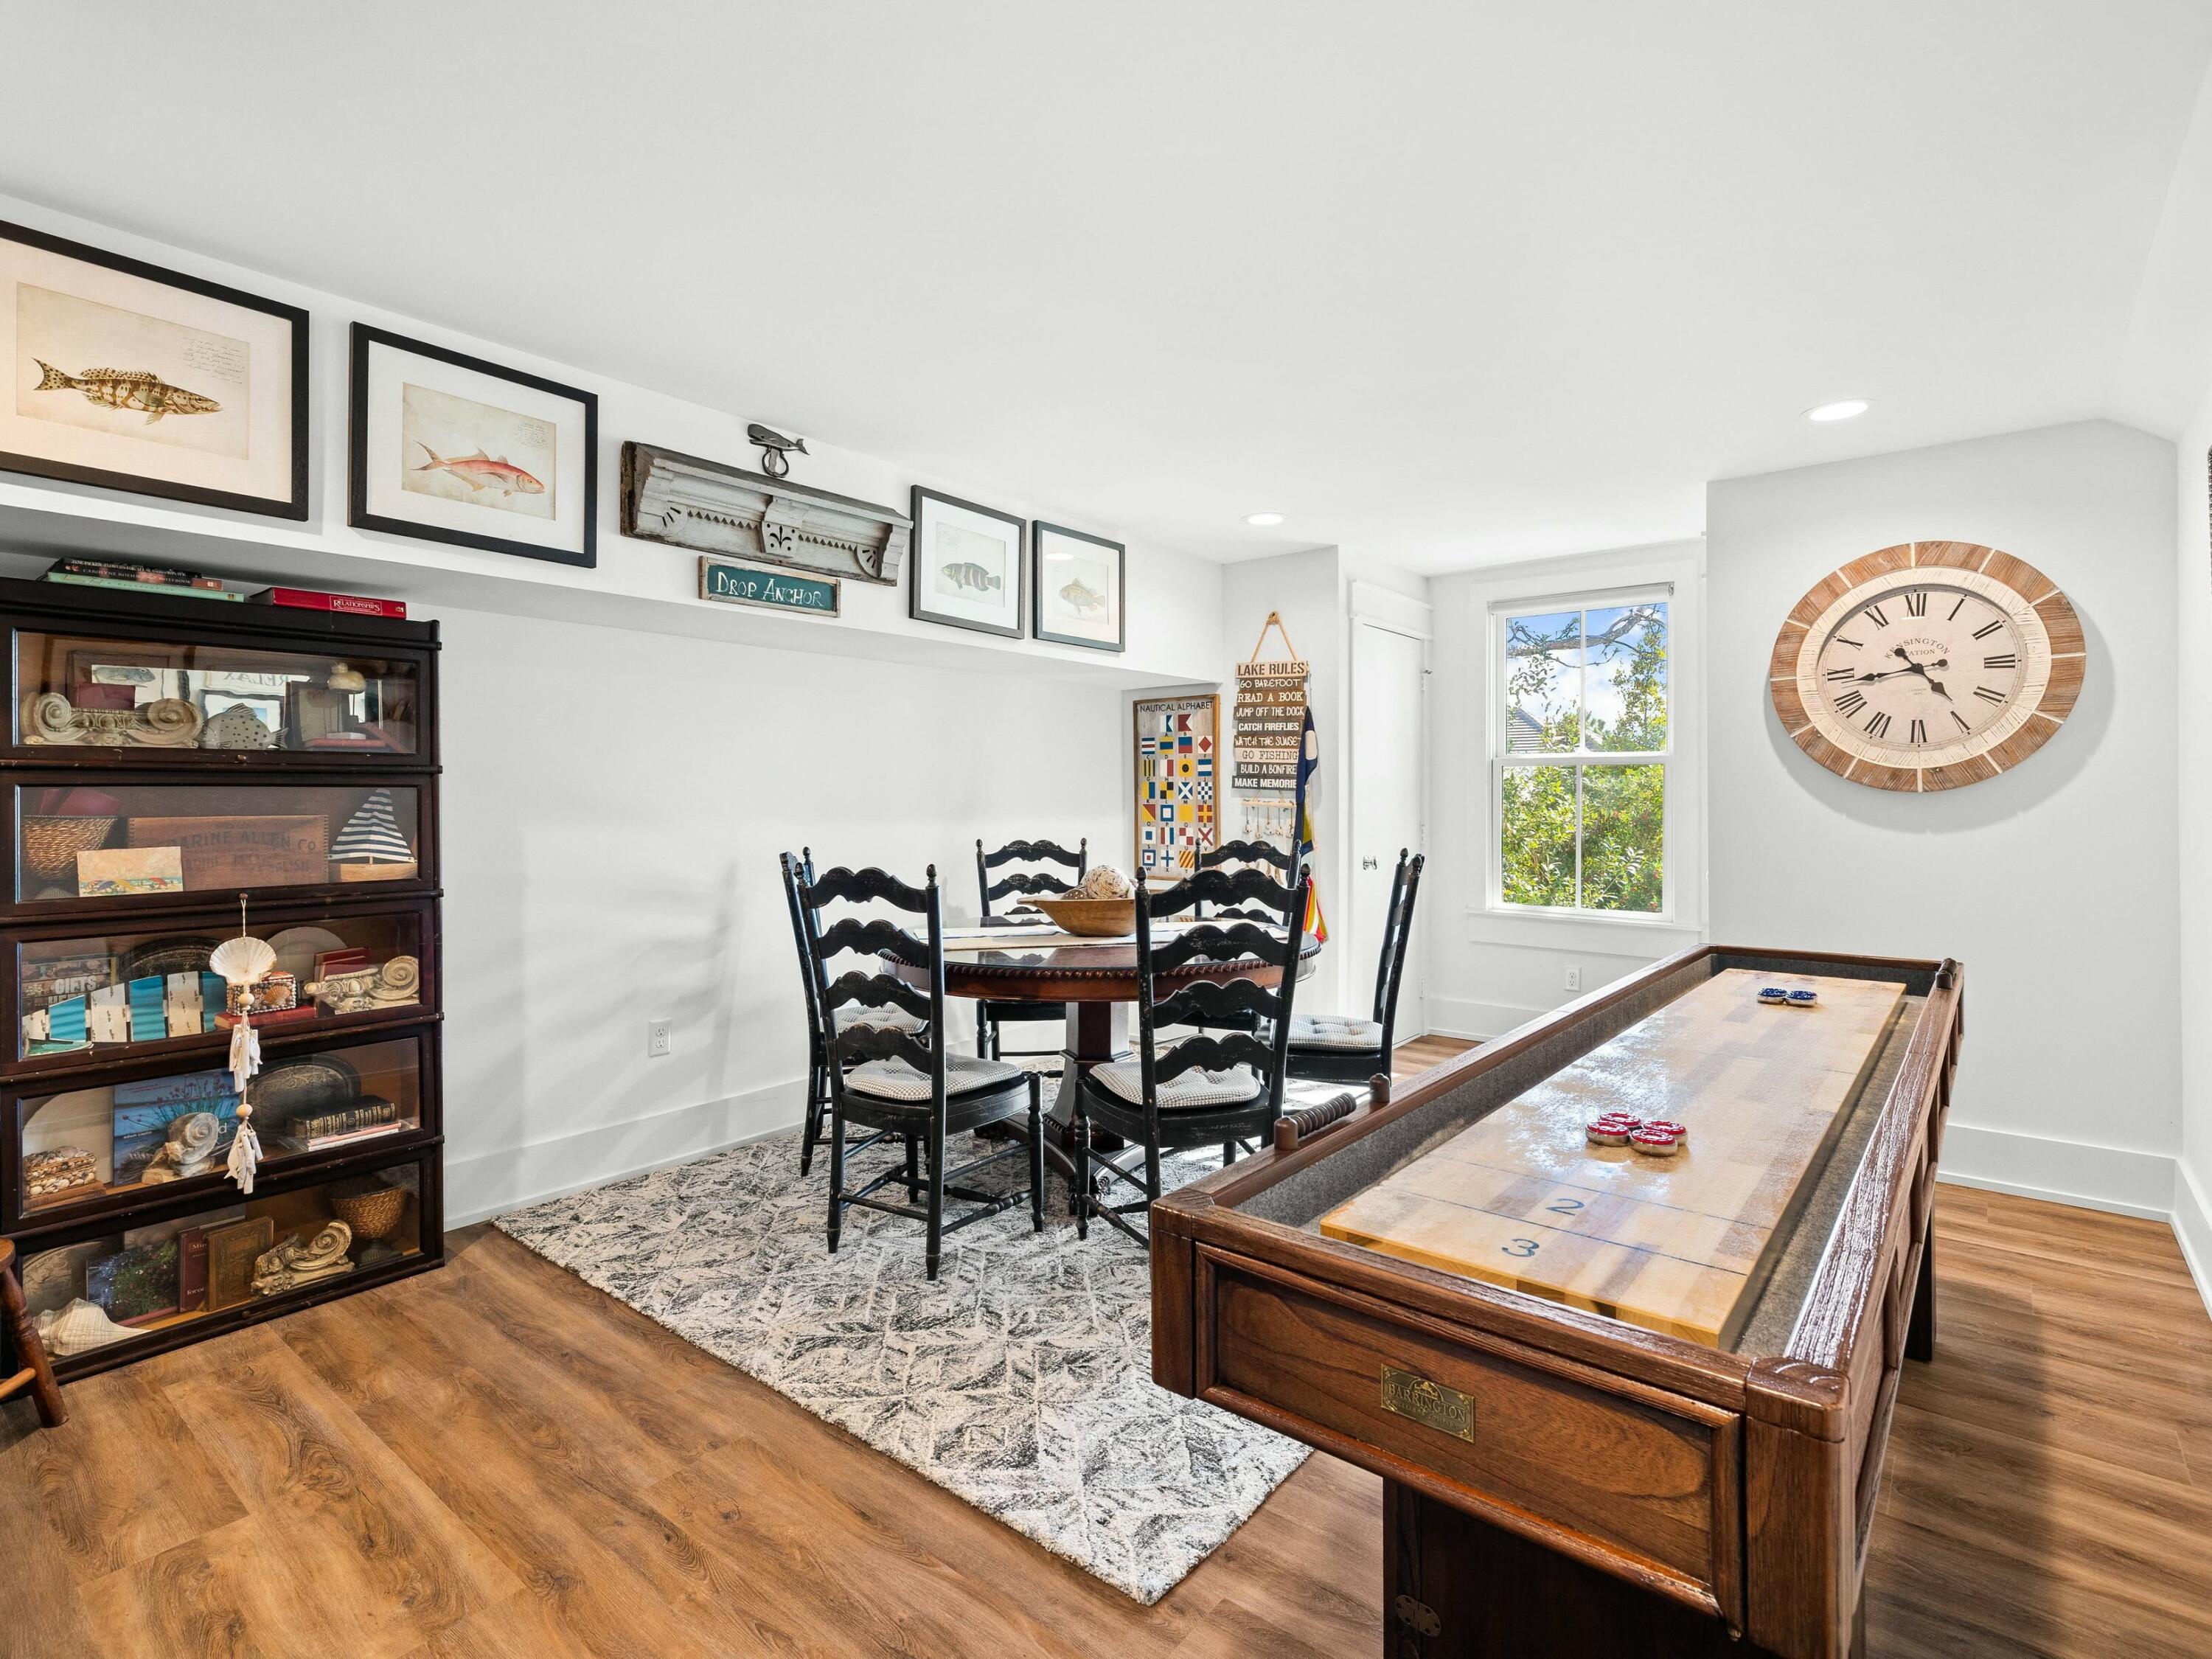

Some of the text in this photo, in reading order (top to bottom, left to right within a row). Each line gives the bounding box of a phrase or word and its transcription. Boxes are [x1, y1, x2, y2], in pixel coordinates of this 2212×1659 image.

[1905, 593, 1927, 617] XII
[1864, 605, 1889, 630] XI
[1972, 619, 2003, 641] II
[1836, 635, 1864, 650] X
[1983, 653, 2015, 669] III
[1237, 662, 1304, 676] LAKE RULES
[1239, 678, 1301, 689] GO BAREFOOT
[1237, 692, 1304, 703] READ A BOOK
[1140, 701, 1213, 712] NAUTICAL ALPHABET
[1237, 706, 1305, 717] JUMP OFF THE DOCK
[1239, 723, 1299, 731] CATCH FIREFLIES
[1234, 736, 1257, 746] WATCH
[1259, 736, 1274, 746] THE
[1242, 751, 1298, 760] GO FISHING
[1240, 764, 1297, 774] BUILD A BONFIRE
[1234, 778, 1297, 788] MAKE MEMORIE
[55, 975, 97, 995] GIFTS
[1545, 1198, 1585, 1217] 2
[1501, 1238, 1540, 1257] 3
[1388, 1383, 1465, 1422] BARRINGTON
